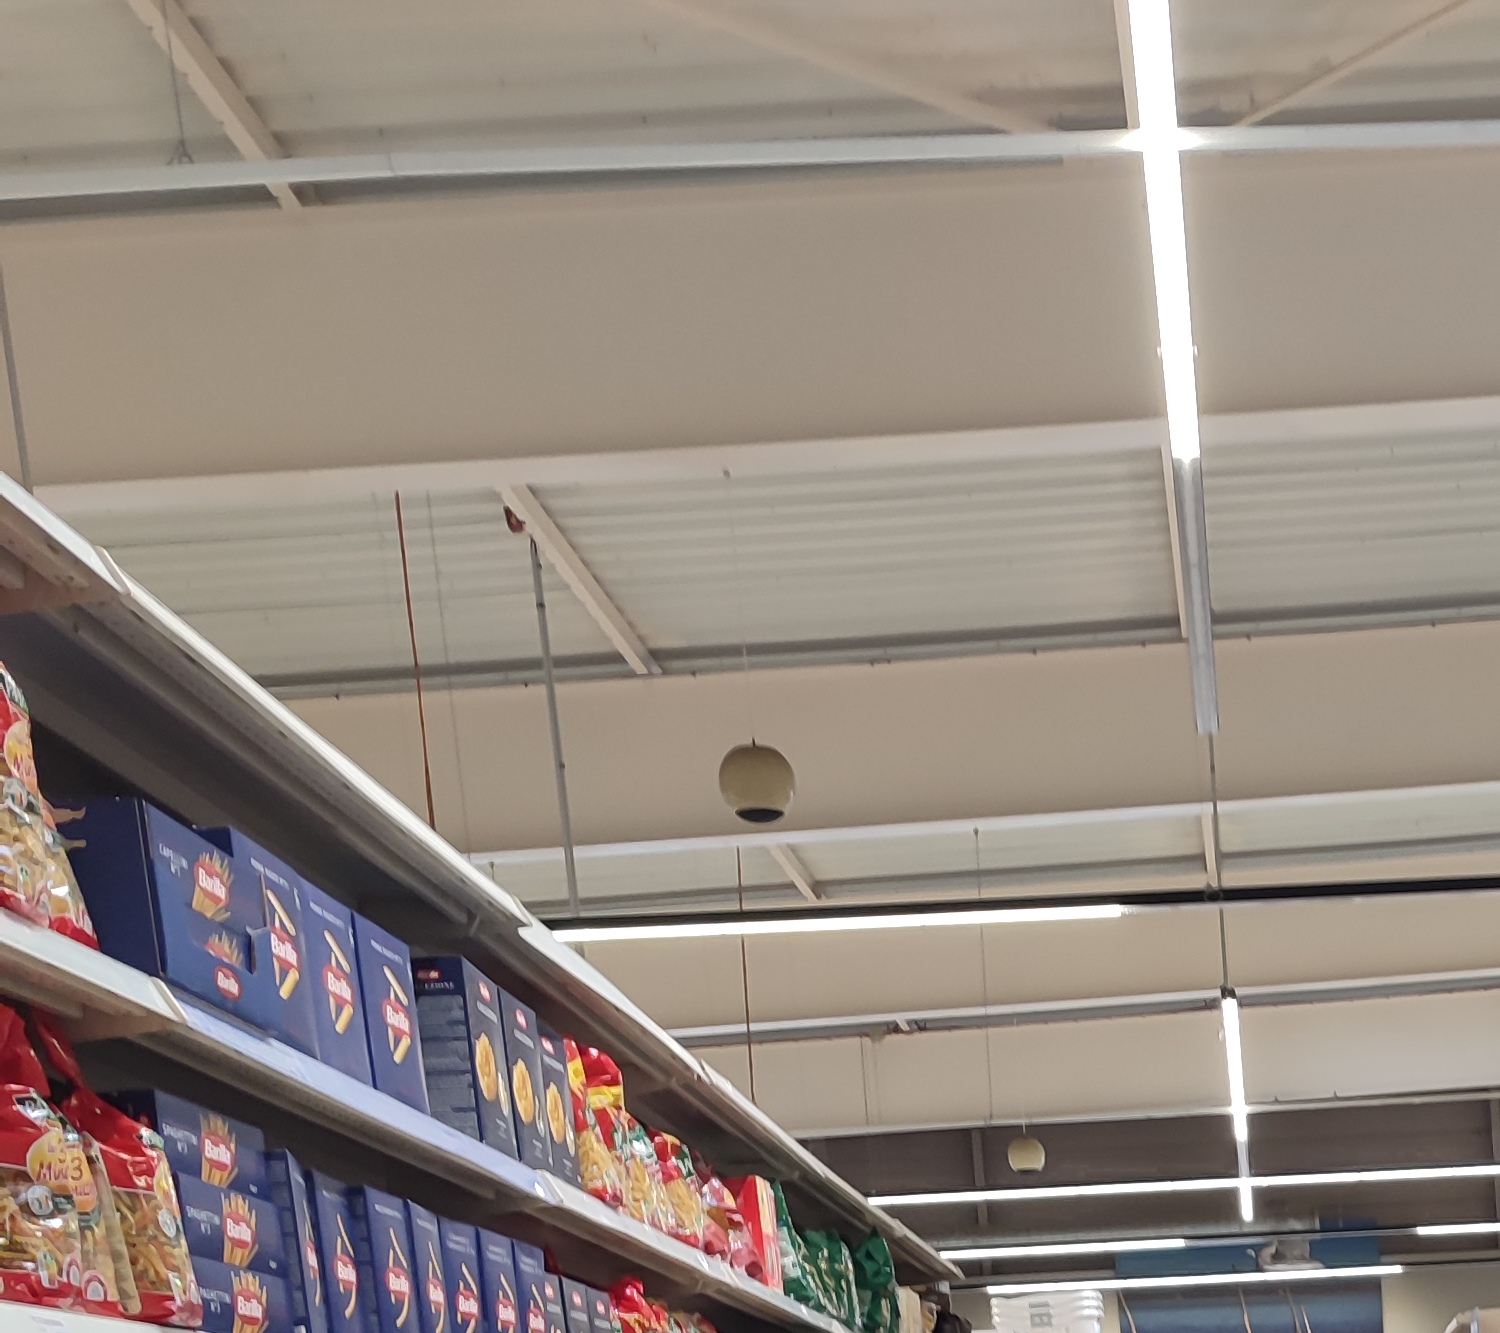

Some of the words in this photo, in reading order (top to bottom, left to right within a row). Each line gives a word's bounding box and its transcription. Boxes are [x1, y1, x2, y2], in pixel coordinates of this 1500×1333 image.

[199, 867, 227, 900] Barilla
[204, 1138, 231, 1168] Barilla
[227, 1216, 252, 1244] Barilla
[238, 1295, 263, 1321] Barilla
